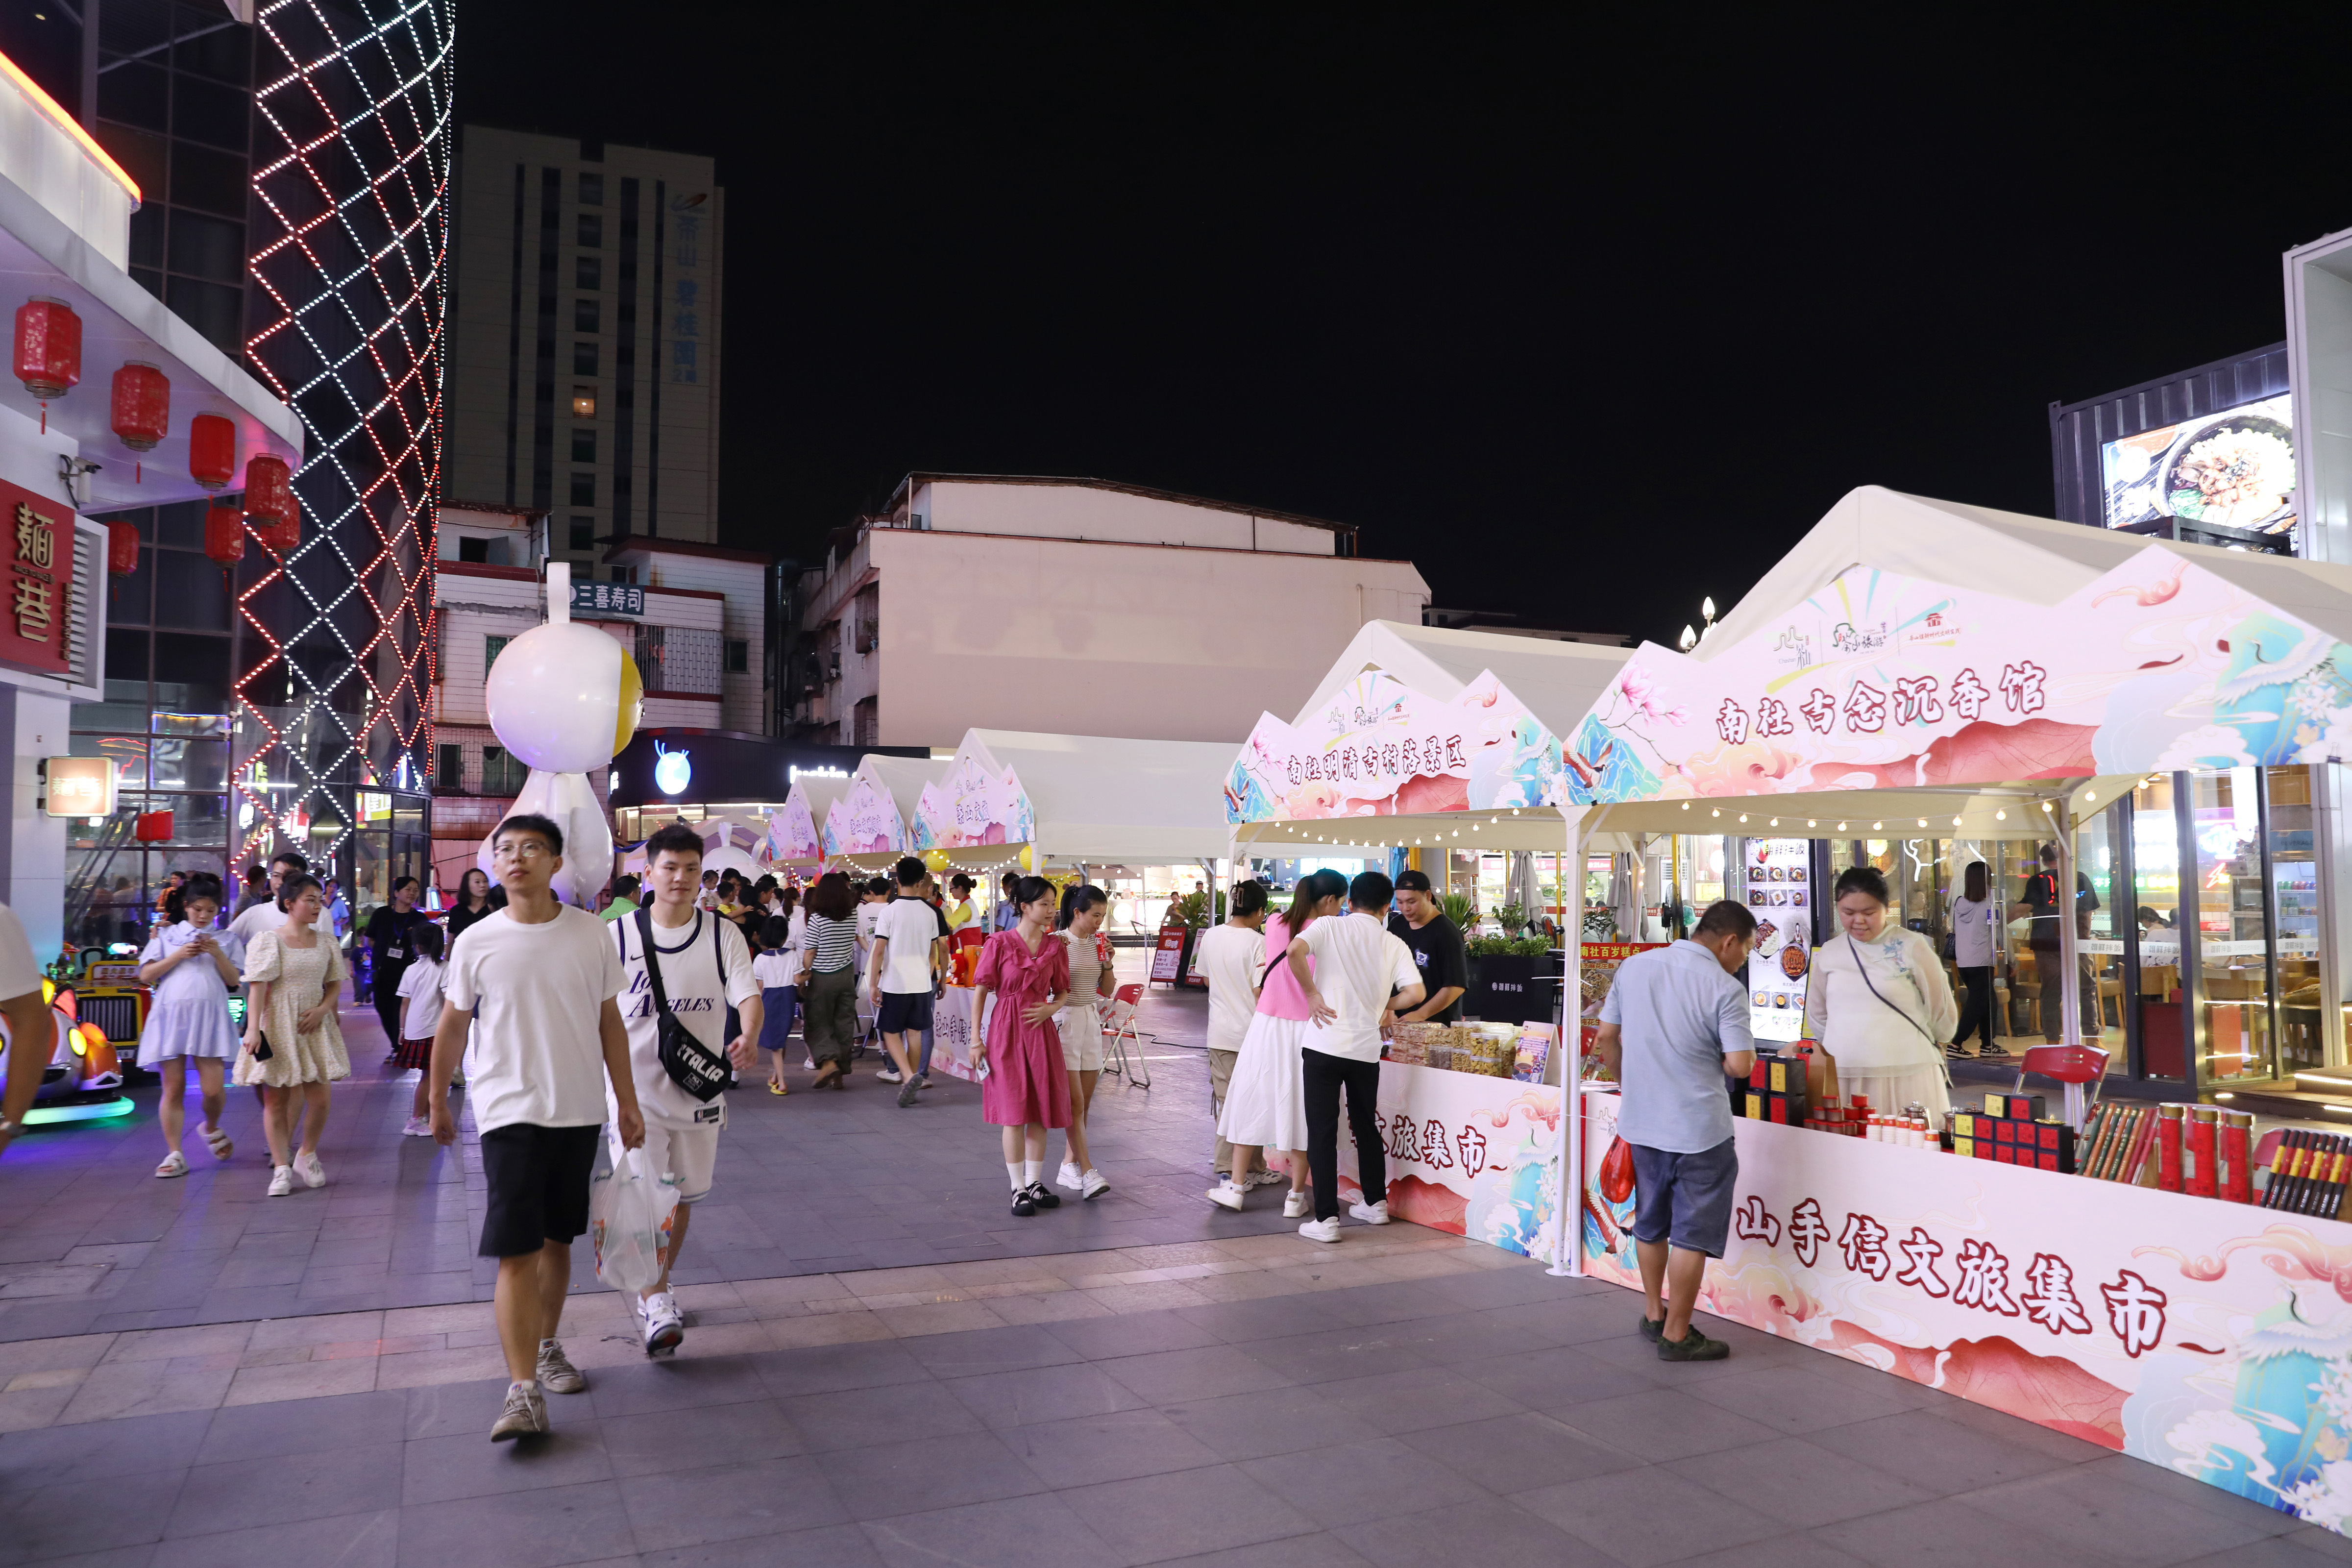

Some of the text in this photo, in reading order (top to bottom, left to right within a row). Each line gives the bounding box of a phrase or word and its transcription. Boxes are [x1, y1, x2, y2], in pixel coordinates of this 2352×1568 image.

[579, 585, 641, 612] 三喜寿司
[1717, 660, 2046, 744] 南社古念沉香馆
[1287, 735, 1466, 785] 南社明清古村落景区
[1581, 946, 1641, 957] 南社百岁糕点
[677, 1043, 725, 1082] ITALIA
[1737, 1196, 2167, 1358] 山手信文旅集市
